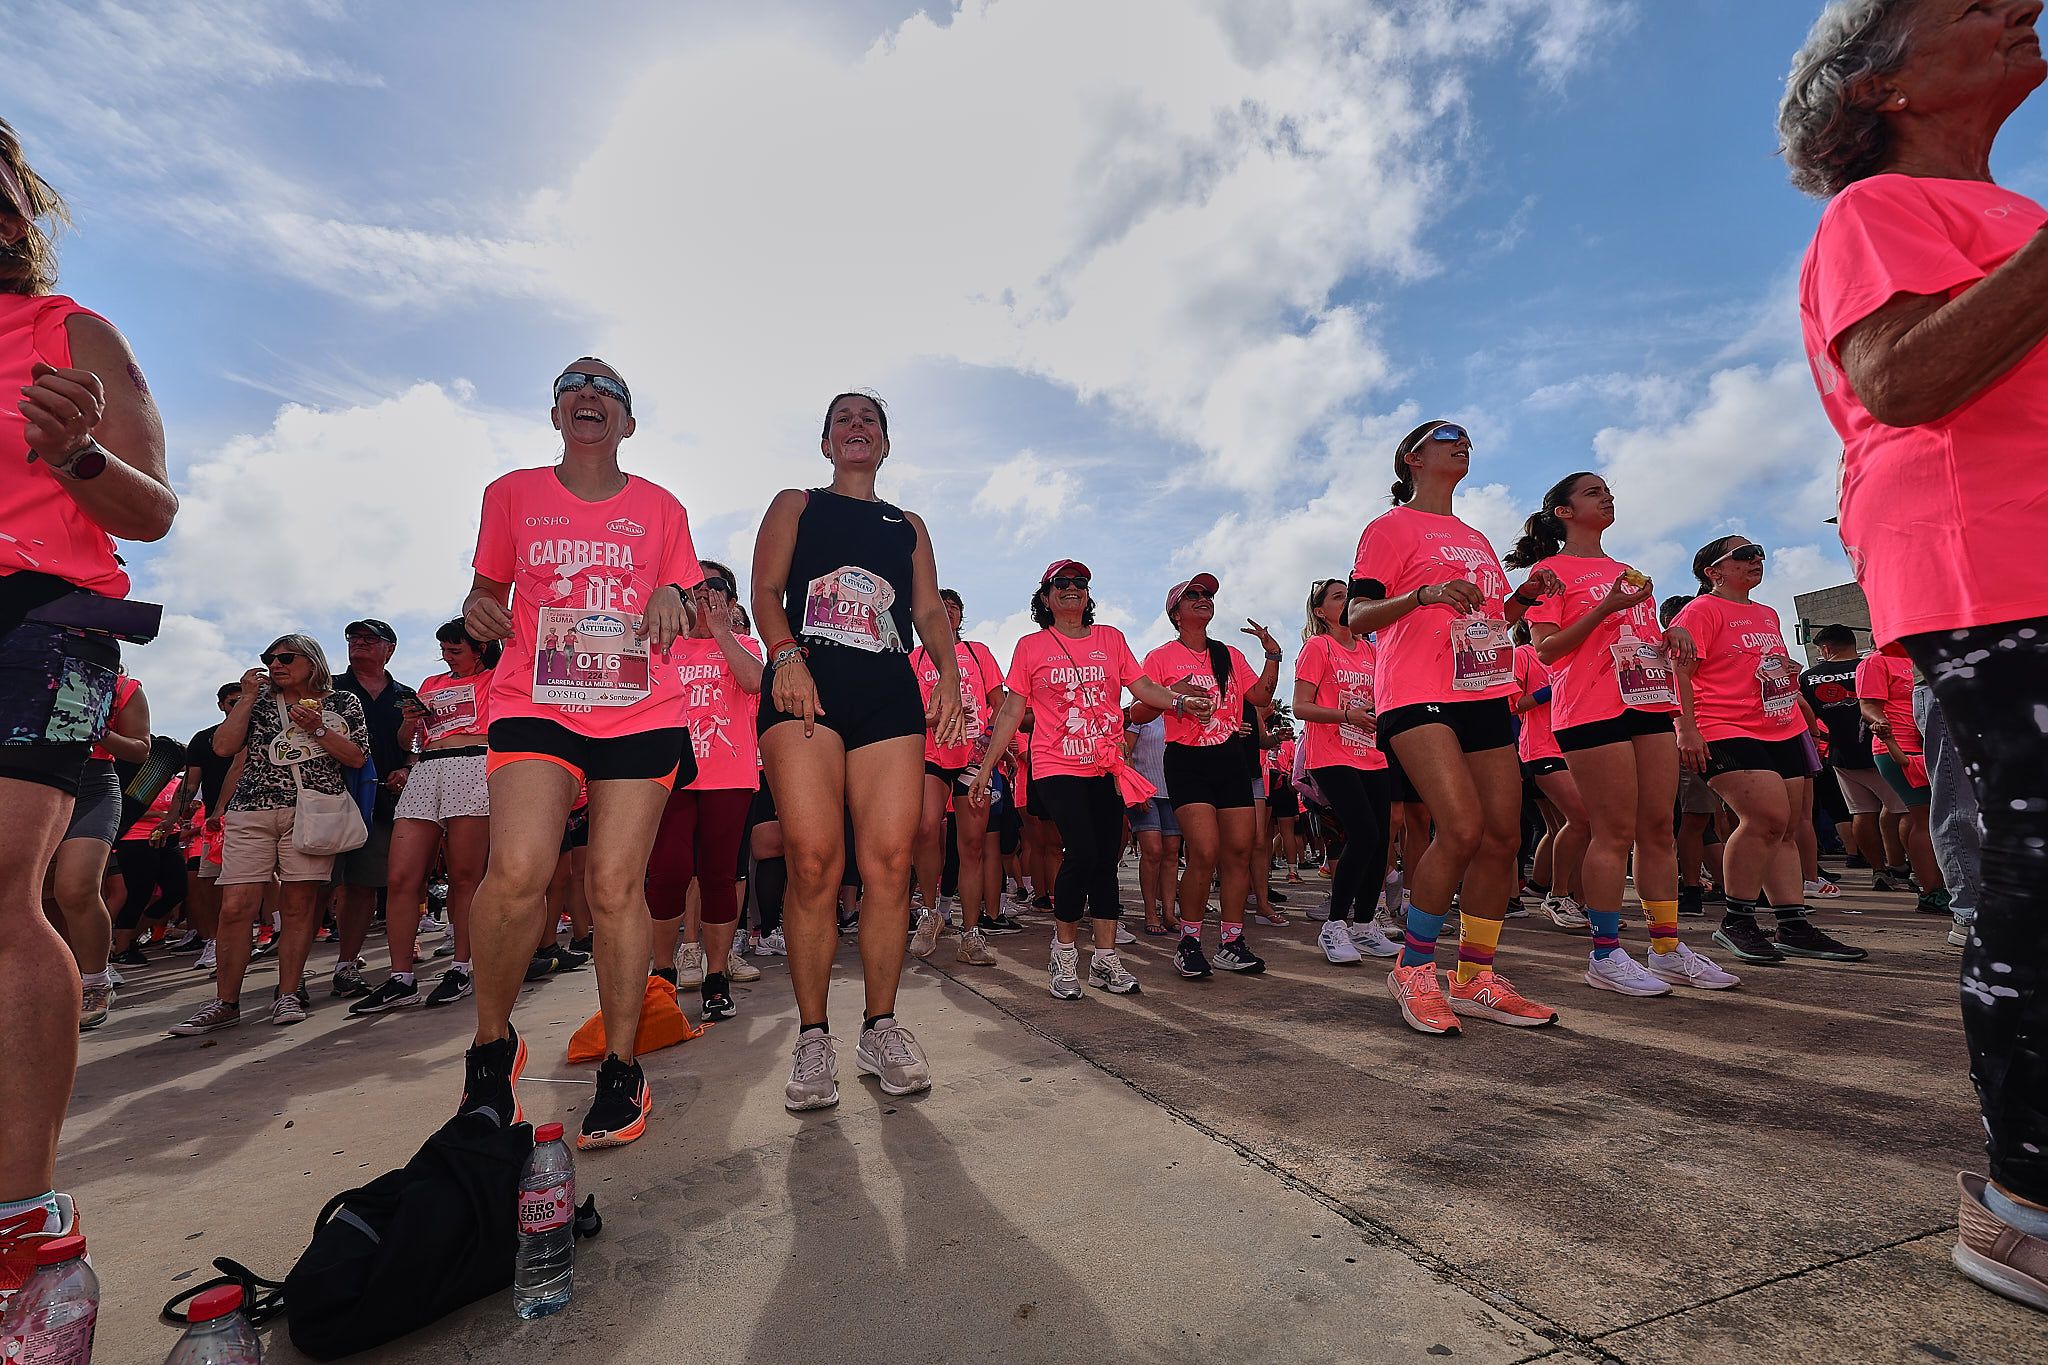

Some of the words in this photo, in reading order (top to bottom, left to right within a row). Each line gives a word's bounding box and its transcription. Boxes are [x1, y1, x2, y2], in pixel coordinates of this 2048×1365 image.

[525, 516, 570, 527] OYSHO
[610, 523, 643, 534] ASTURIANA
[528, 539, 634, 571] CARRERA
[1574, 571, 1603, 584] OYSHO
[586, 575, 620, 611] DE
[838, 601, 870, 618] 016
[579, 622, 622, 633] ASTURIANA
[576, 653, 621, 670] 016
[1475, 649, 1498, 662] 016
[587, 672, 609, 680] 2245
[677, 664, 722, 679] RRERA
[1050, 665, 1106, 684] CARRERA
[1645, 668, 1666, 679] 016
[547, 678, 575, 686] CARRERA
[1463, 679, 1487, 687] OYSHO
[547, 690, 586, 700] OYSHO
[609, 693, 640, 701] Santander
[690, 684, 712, 707] DE
[1631, 693, 1659, 702] OYSHO
[436, 704, 457, 716] 016
[1084, 719, 1098, 738] LA
[1062, 736, 1098, 756] MUJ
[521, 1201, 555, 1214] ZERO
[520, 1210, 555, 1222] SODIO
